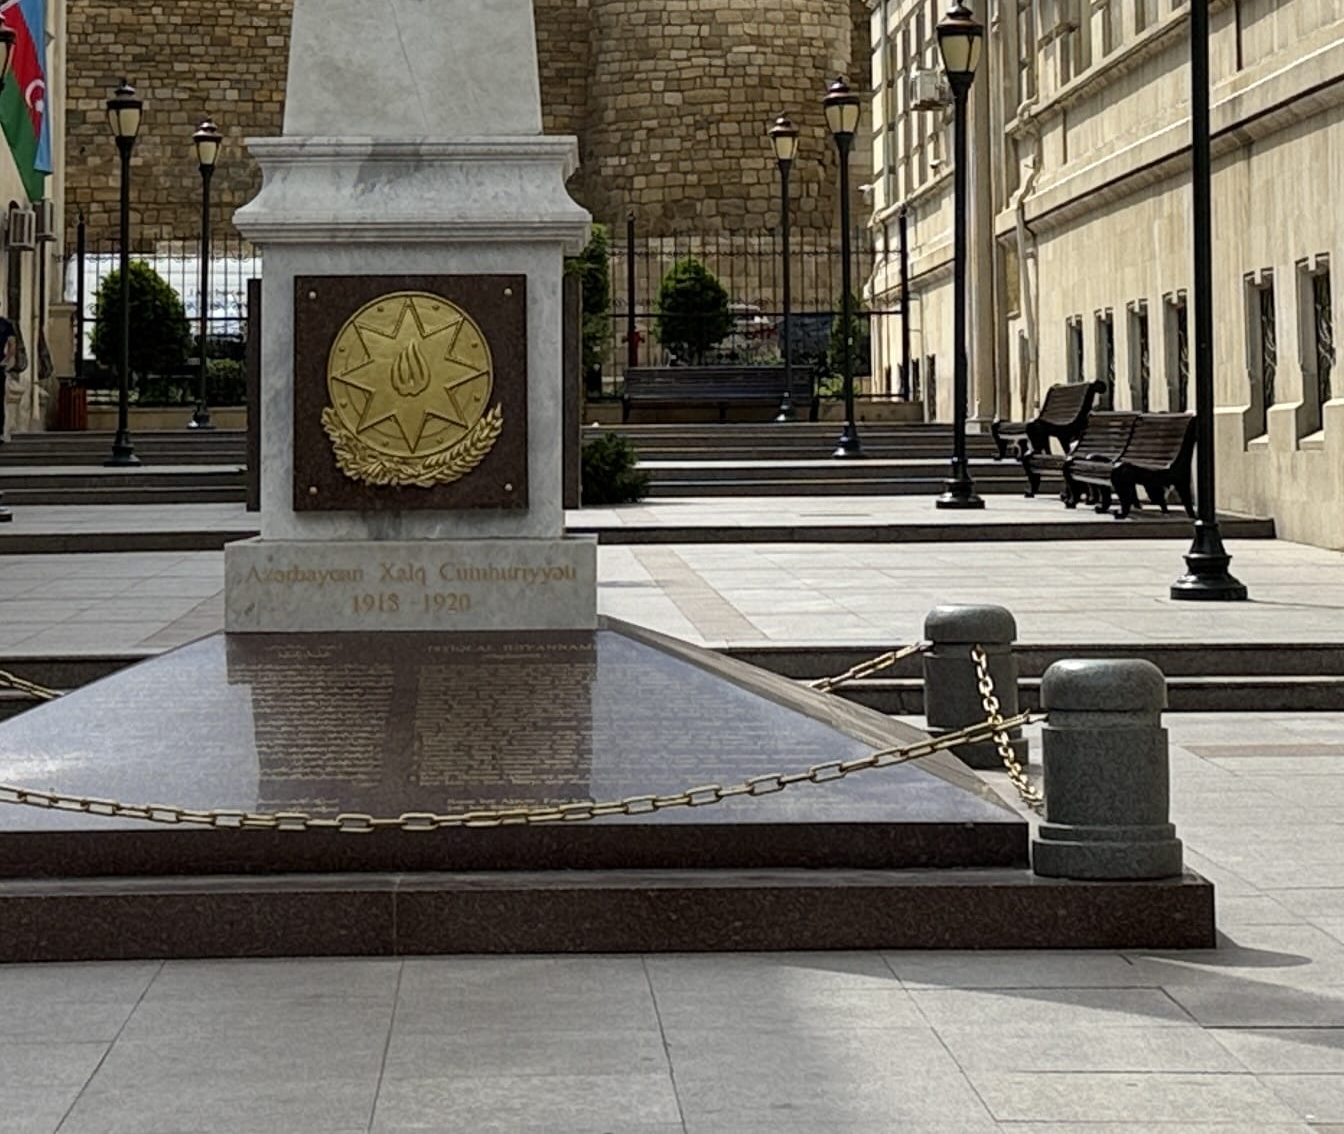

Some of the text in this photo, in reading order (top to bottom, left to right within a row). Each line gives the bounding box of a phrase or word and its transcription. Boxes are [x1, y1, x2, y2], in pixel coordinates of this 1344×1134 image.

[246, 562, 364, 589] Azərbaycan
[379, 562, 426, 587] Xalq
[353, 593, 401, 613] 1918
[423, 593, 472, 613] 1920
